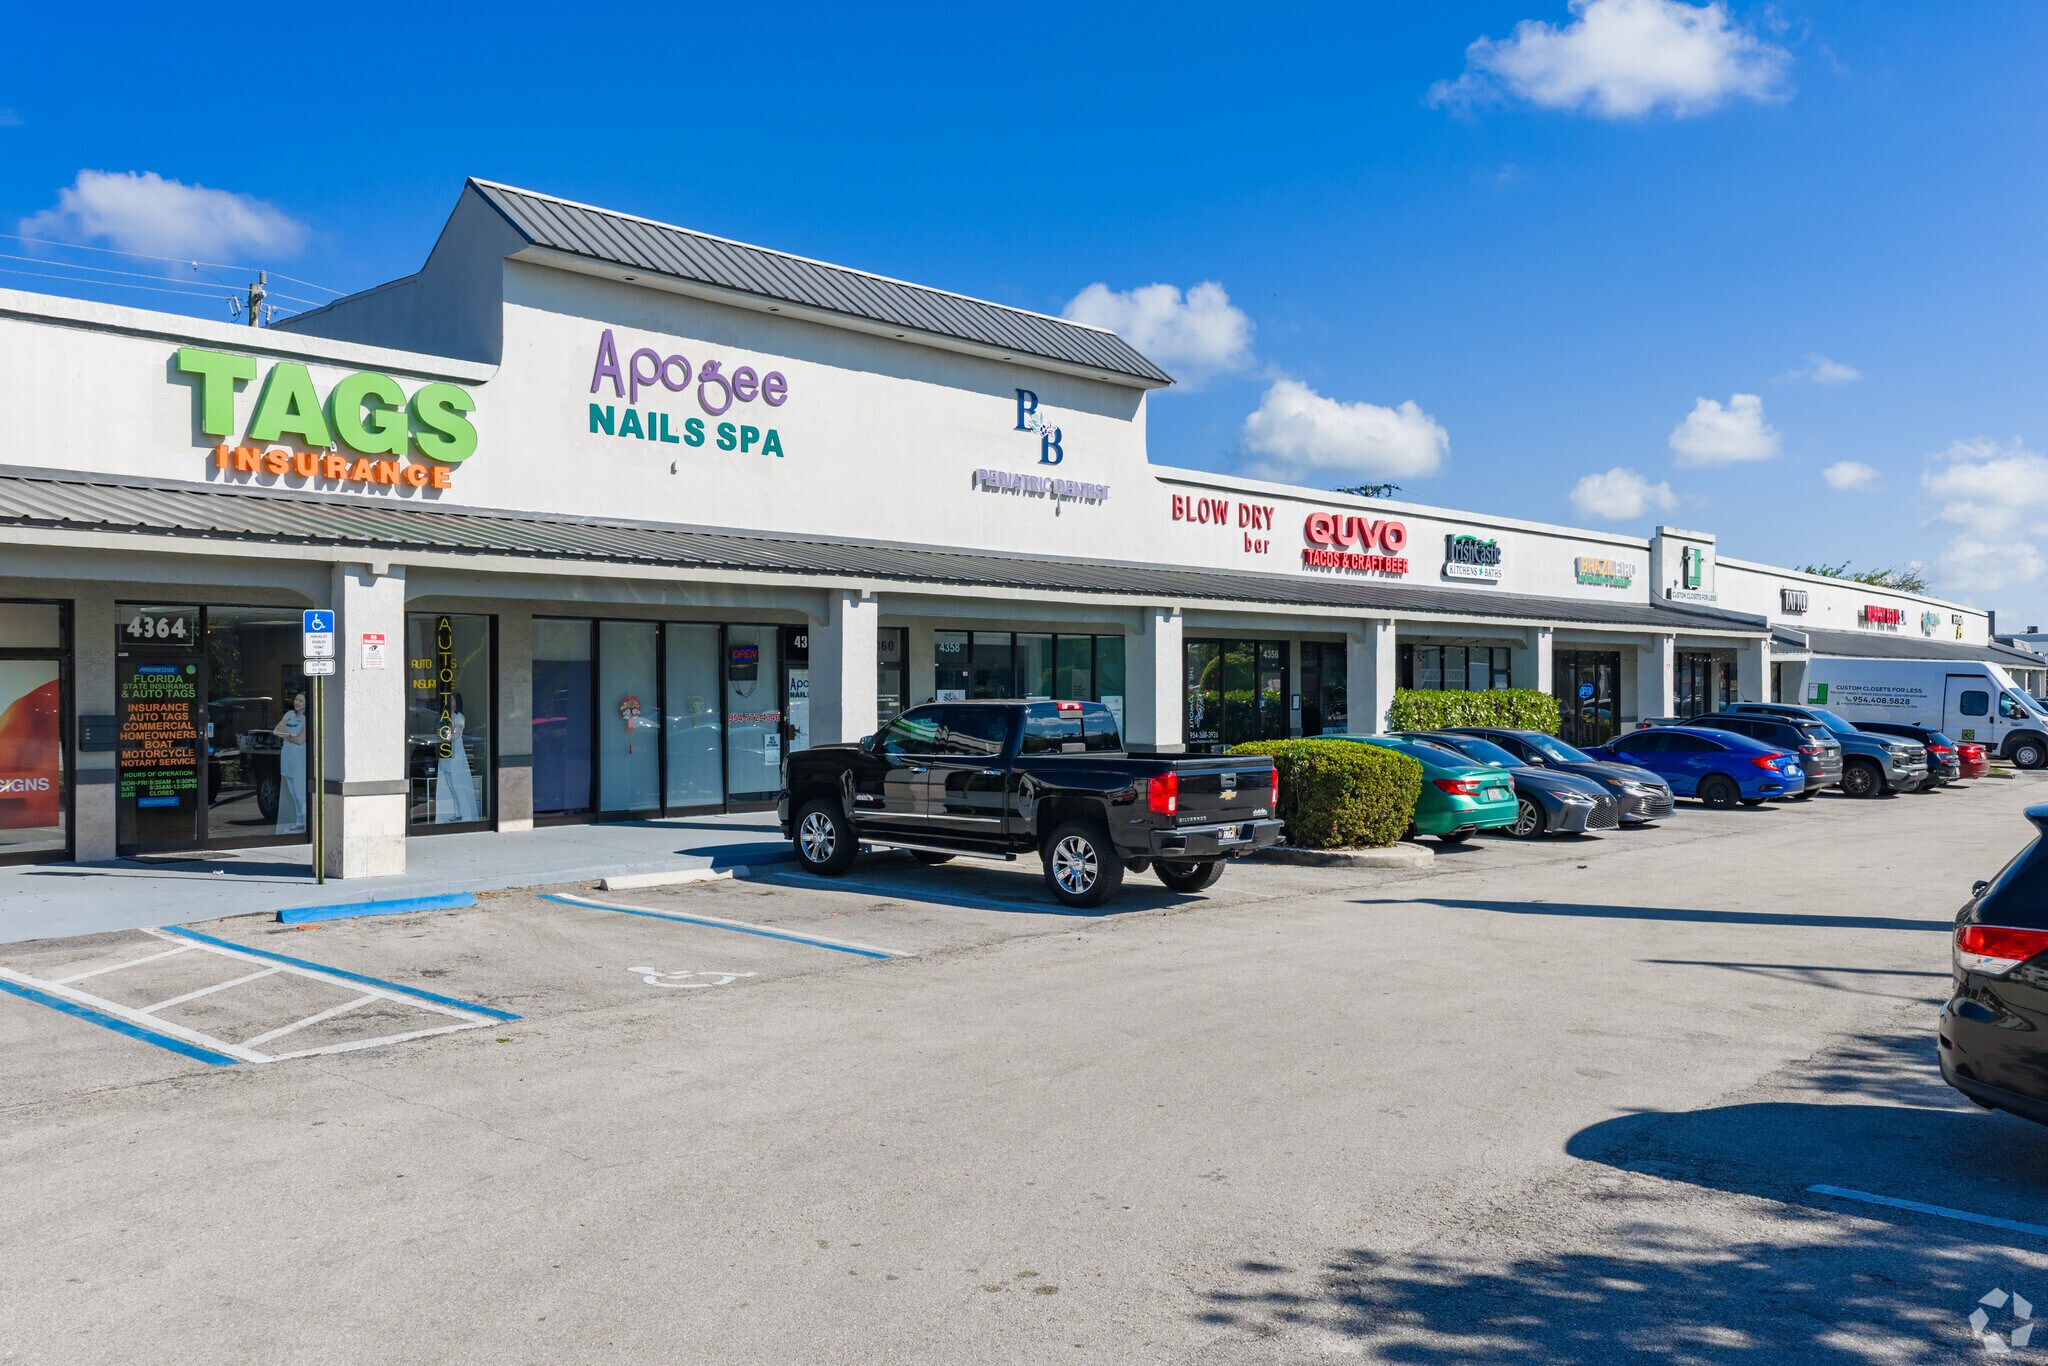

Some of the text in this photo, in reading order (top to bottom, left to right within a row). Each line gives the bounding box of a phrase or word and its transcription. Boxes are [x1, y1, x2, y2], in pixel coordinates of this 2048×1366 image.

[591, 329, 788, 415] Apogee
[176, 347, 478, 463] TAGS
[589, 403, 784, 457] NAILS SPA
[1038, 425, 1063, 466] B
[215, 444, 452, 489] INSURANCE
[978, 468, 1110, 500] PEDIATRIC DENTIST
[1172, 494, 1275, 531] BLOW DRY
[1305, 511, 1407, 551] QUVO
[1244, 532, 1270, 554] bar
[1307, 549, 1409, 573] TACOS & CRAFT BEER
[1580, 556, 1637, 578] BRAZILEIRO
[1449, 565, 1502, 578] KITCHENS BATHS
[1784, 590, 1808, 611] TATTOO
[127, 616, 186, 639] 4364
[794, 635, 808, 648] 43
[878, 640, 894, 652] 60
[939, 643, 961, 653] 4358
[438, 617, 452, 683] AUTO
[733, 649, 757, 660] OPEN
[1263, 650, 1279, 659] 4356
[411, 659, 432, 668] AUTO
[133, 674, 183, 683] FLORIDA
[121, 689, 196, 698] & AUTO TAGS
[1852, 696, 1911, 705] 954.408.5828
[128, 703, 189, 712] INSURANCE
[129, 712, 189, 721] AUTO TAGS
[123, 722, 194, 731] COMMERCIAL
[120, 731, 197, 740] HOMEOWNERS
[144, 740, 173, 749] BOAT
[122, 749, 195, 759] MOTORCYCLE
[159, 758, 196, 766] SERVICE
